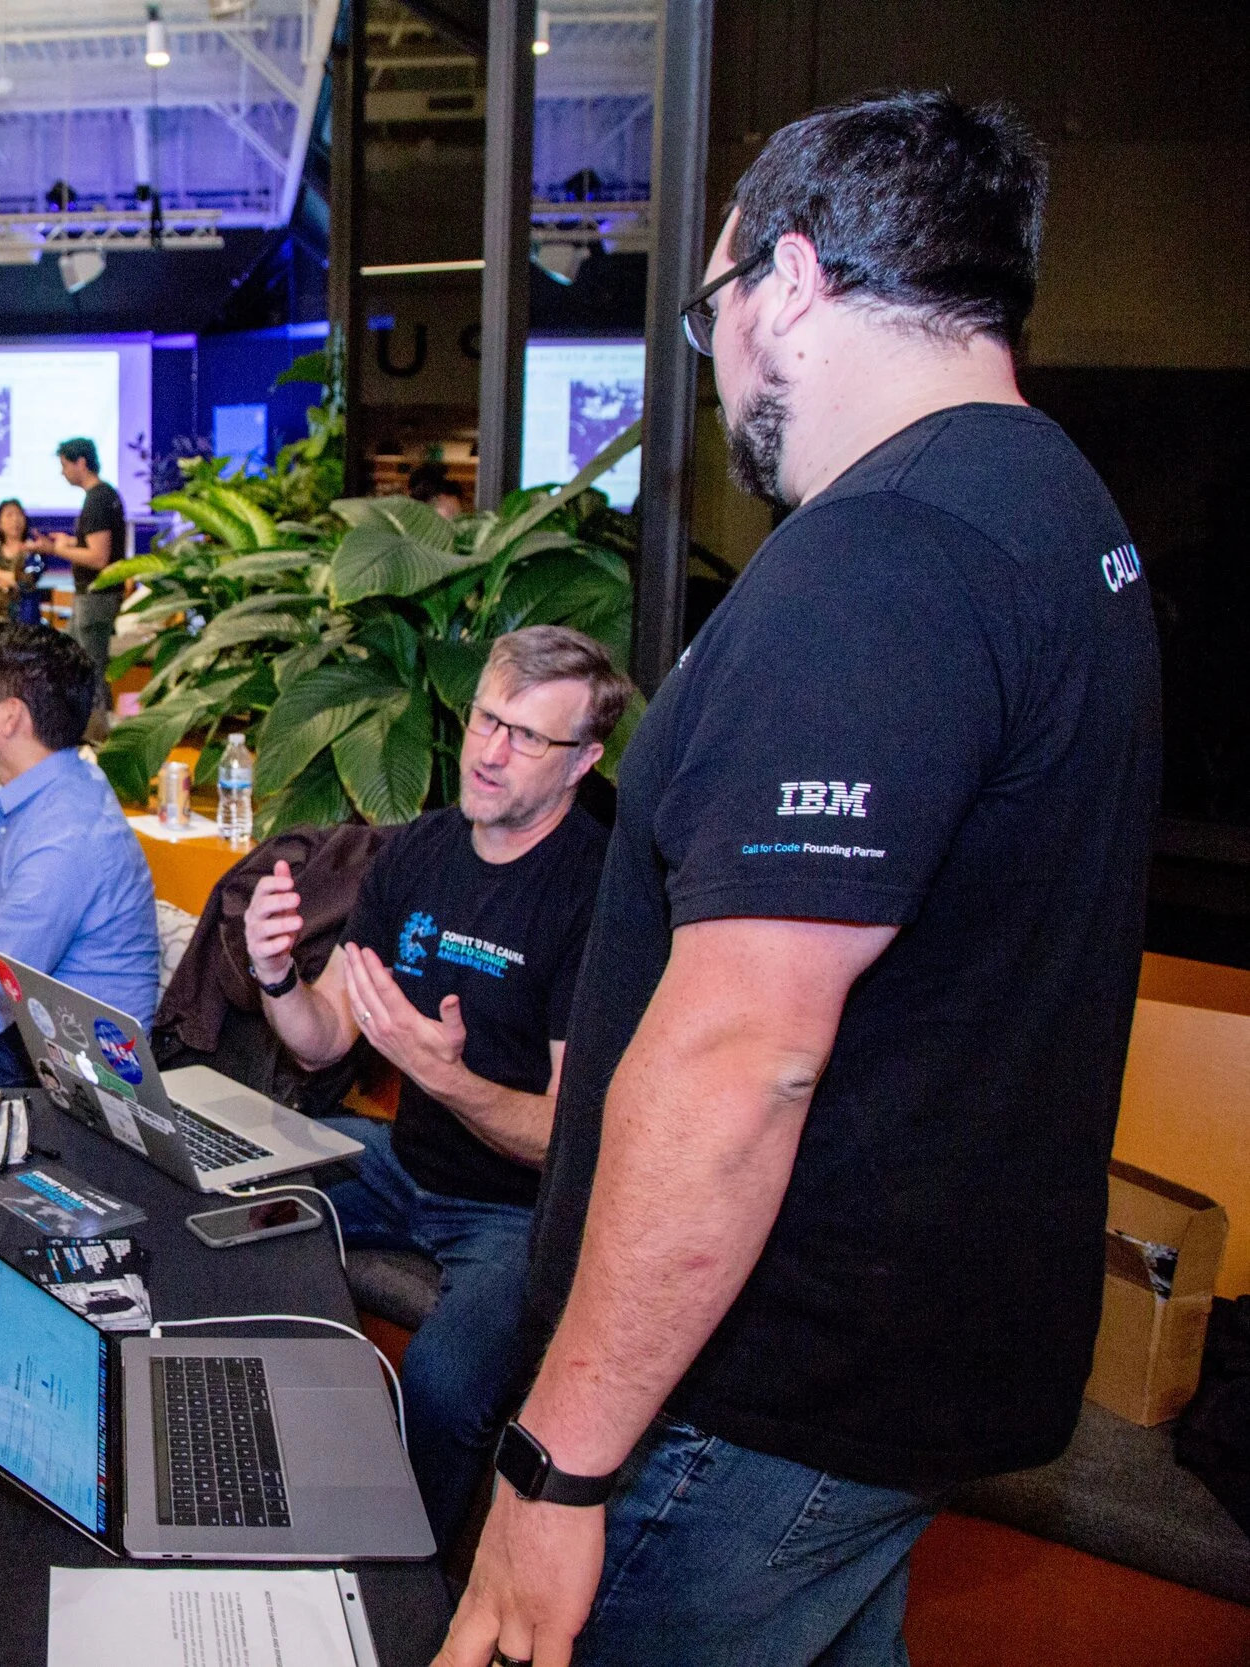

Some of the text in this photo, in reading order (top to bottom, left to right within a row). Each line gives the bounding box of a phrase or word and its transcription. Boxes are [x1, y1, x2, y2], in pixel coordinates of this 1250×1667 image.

[1101, 544, 1138, 593] CALL
[776, 780, 871, 818] IBM
[742, 843, 758, 854] Call
[760, 843, 773, 853] for
[774, 843, 801, 853] Code
[803, 843, 851, 858] Founding
[98, 1036, 139, 1066] NASA
